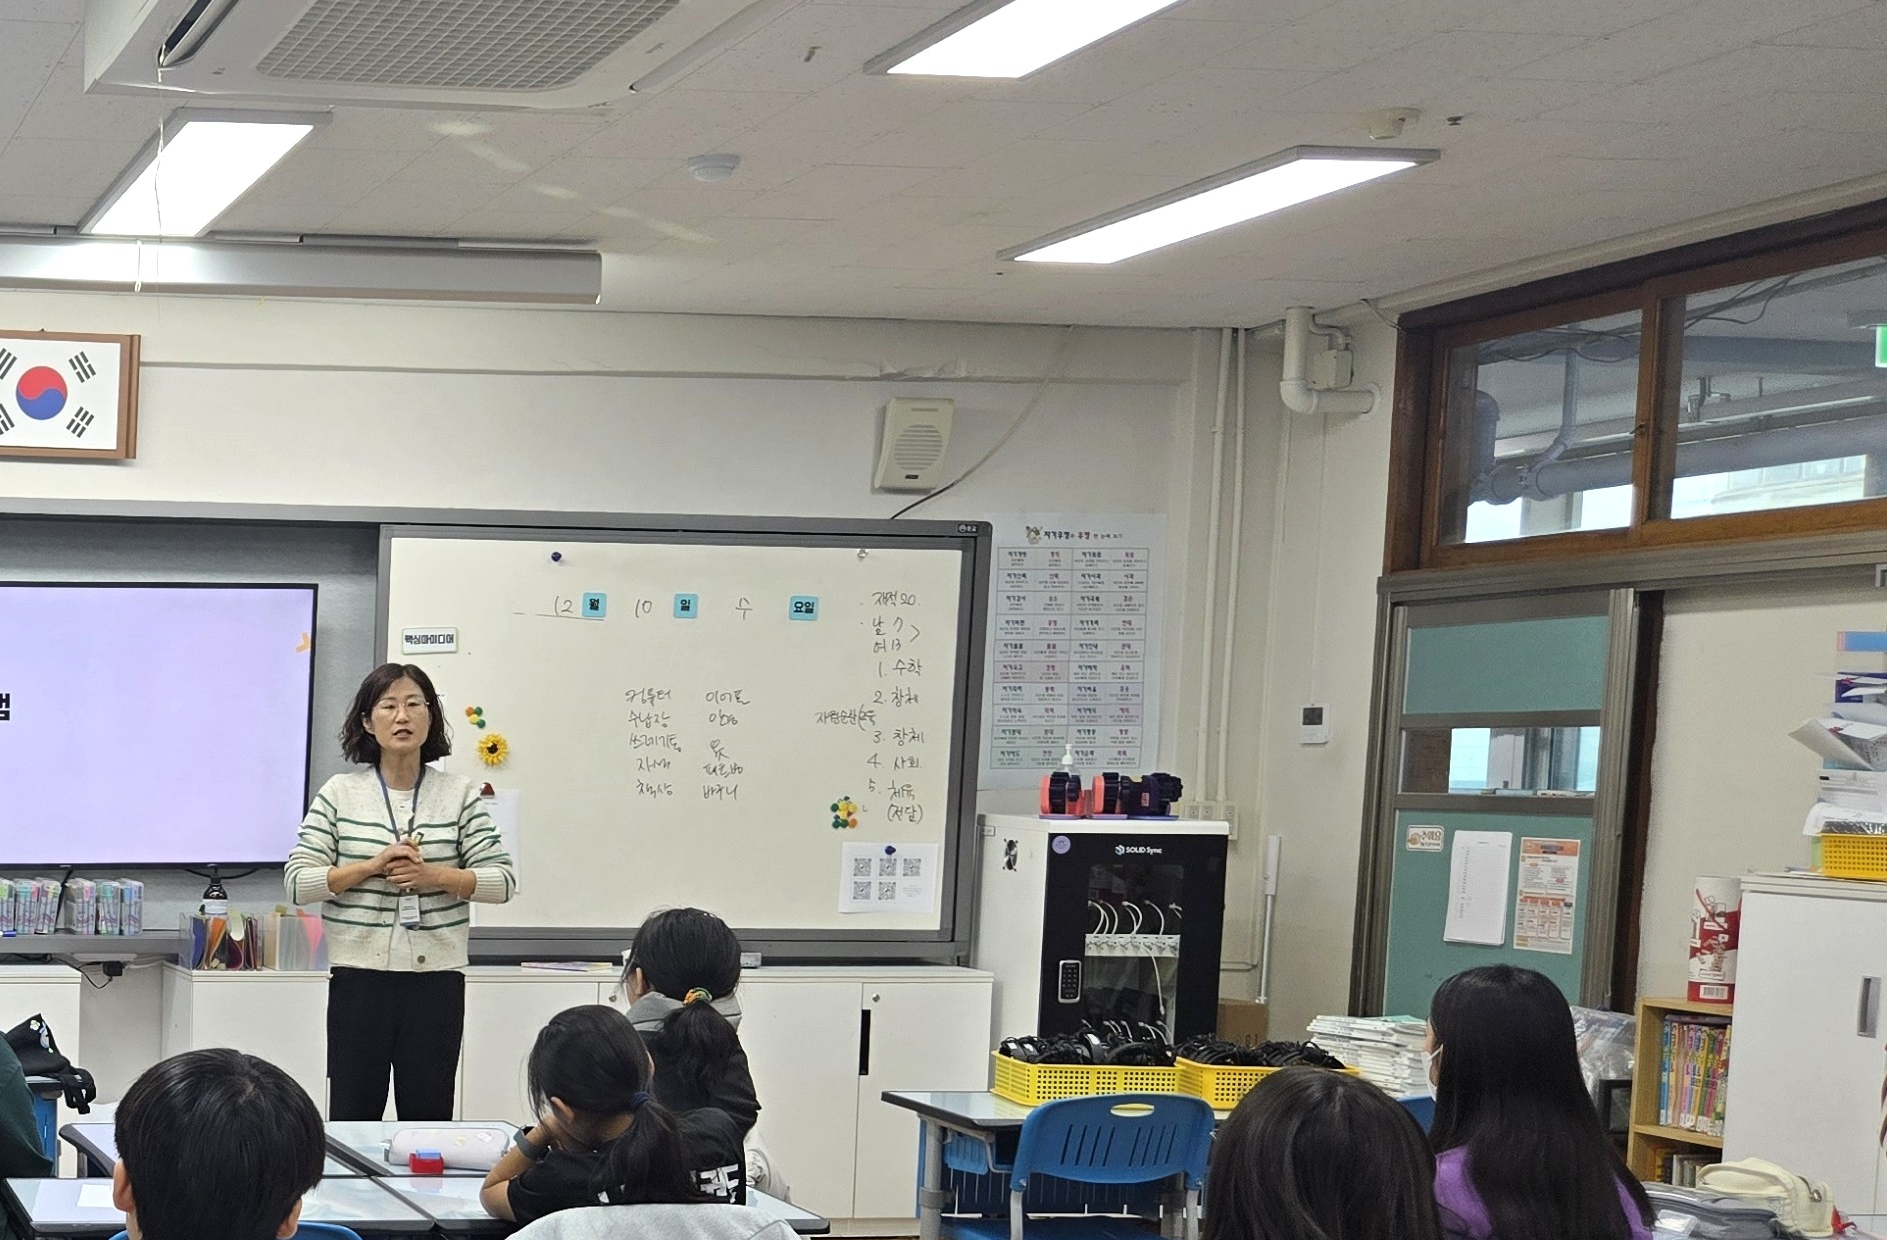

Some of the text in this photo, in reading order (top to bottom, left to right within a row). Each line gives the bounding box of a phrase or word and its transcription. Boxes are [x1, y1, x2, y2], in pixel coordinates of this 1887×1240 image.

[554, 596, 574, 614] 12
[589, 599, 600, 611] 월
[634, 599, 653, 618] 10
[680, 599, 690, 611] 일
[793, 601, 815, 614] 요일
[1125, 846, 1146, 854] SOLID
